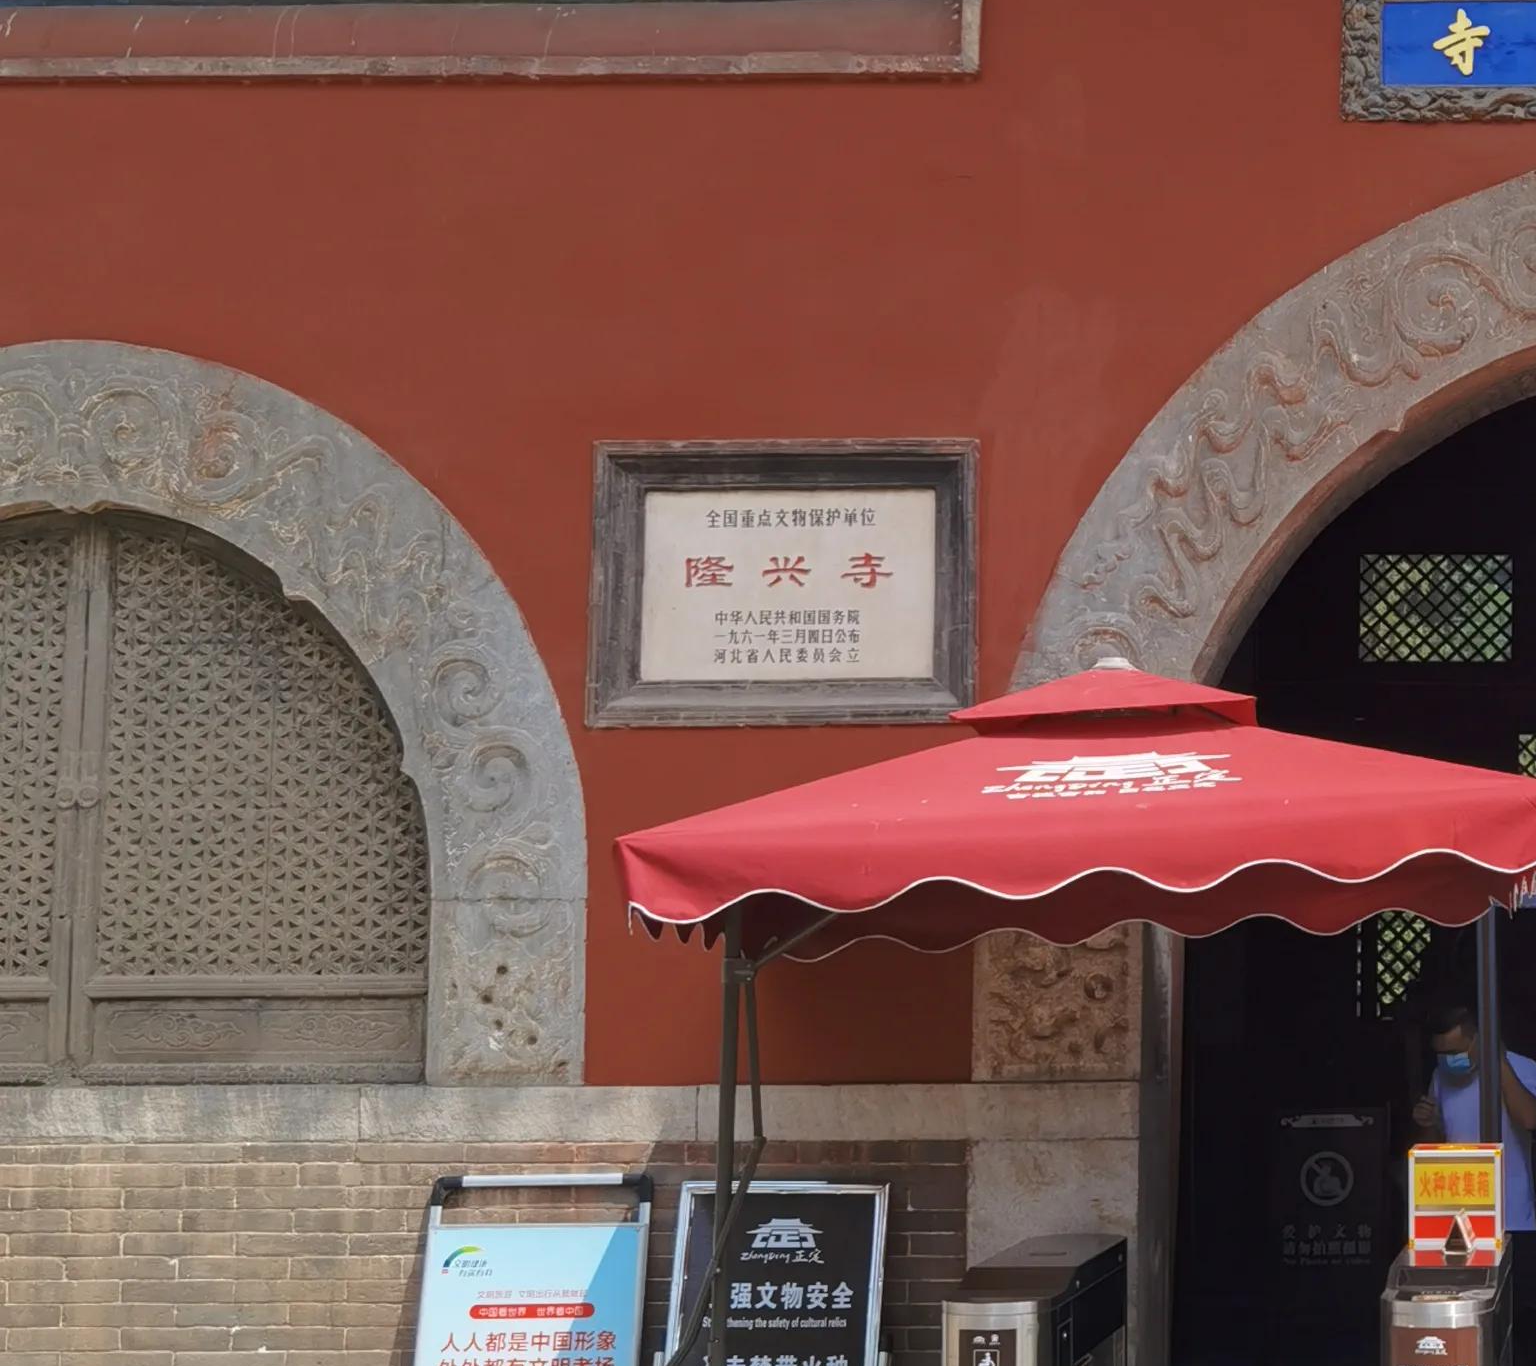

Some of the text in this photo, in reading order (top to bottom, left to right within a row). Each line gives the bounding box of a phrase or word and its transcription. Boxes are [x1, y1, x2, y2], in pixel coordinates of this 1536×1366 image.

[705, 508, 877, 529] 全国重点文物保护单位
[684, 552, 894, 589] 隆兴寺
[714, 609, 860, 626] 中华人民共和国国务院
[714, 629, 860, 644] 一九六一年三月四日公布
[714, 647, 860, 664] 河北省人民委员会立
[1419, 1171, 1490, 1198] 火种收集箱
[730, 1281, 854, 1310] 强文物安全
[755, 1317, 767, 1328] the
[768, 1316, 790, 1330] safety
[791, 1316, 800, 1328] of
[800, 1316, 827, 1328] cultural
[828, 1316, 847, 1328] relics
[441, 1330, 617, 1353] 人人都是中国形象
